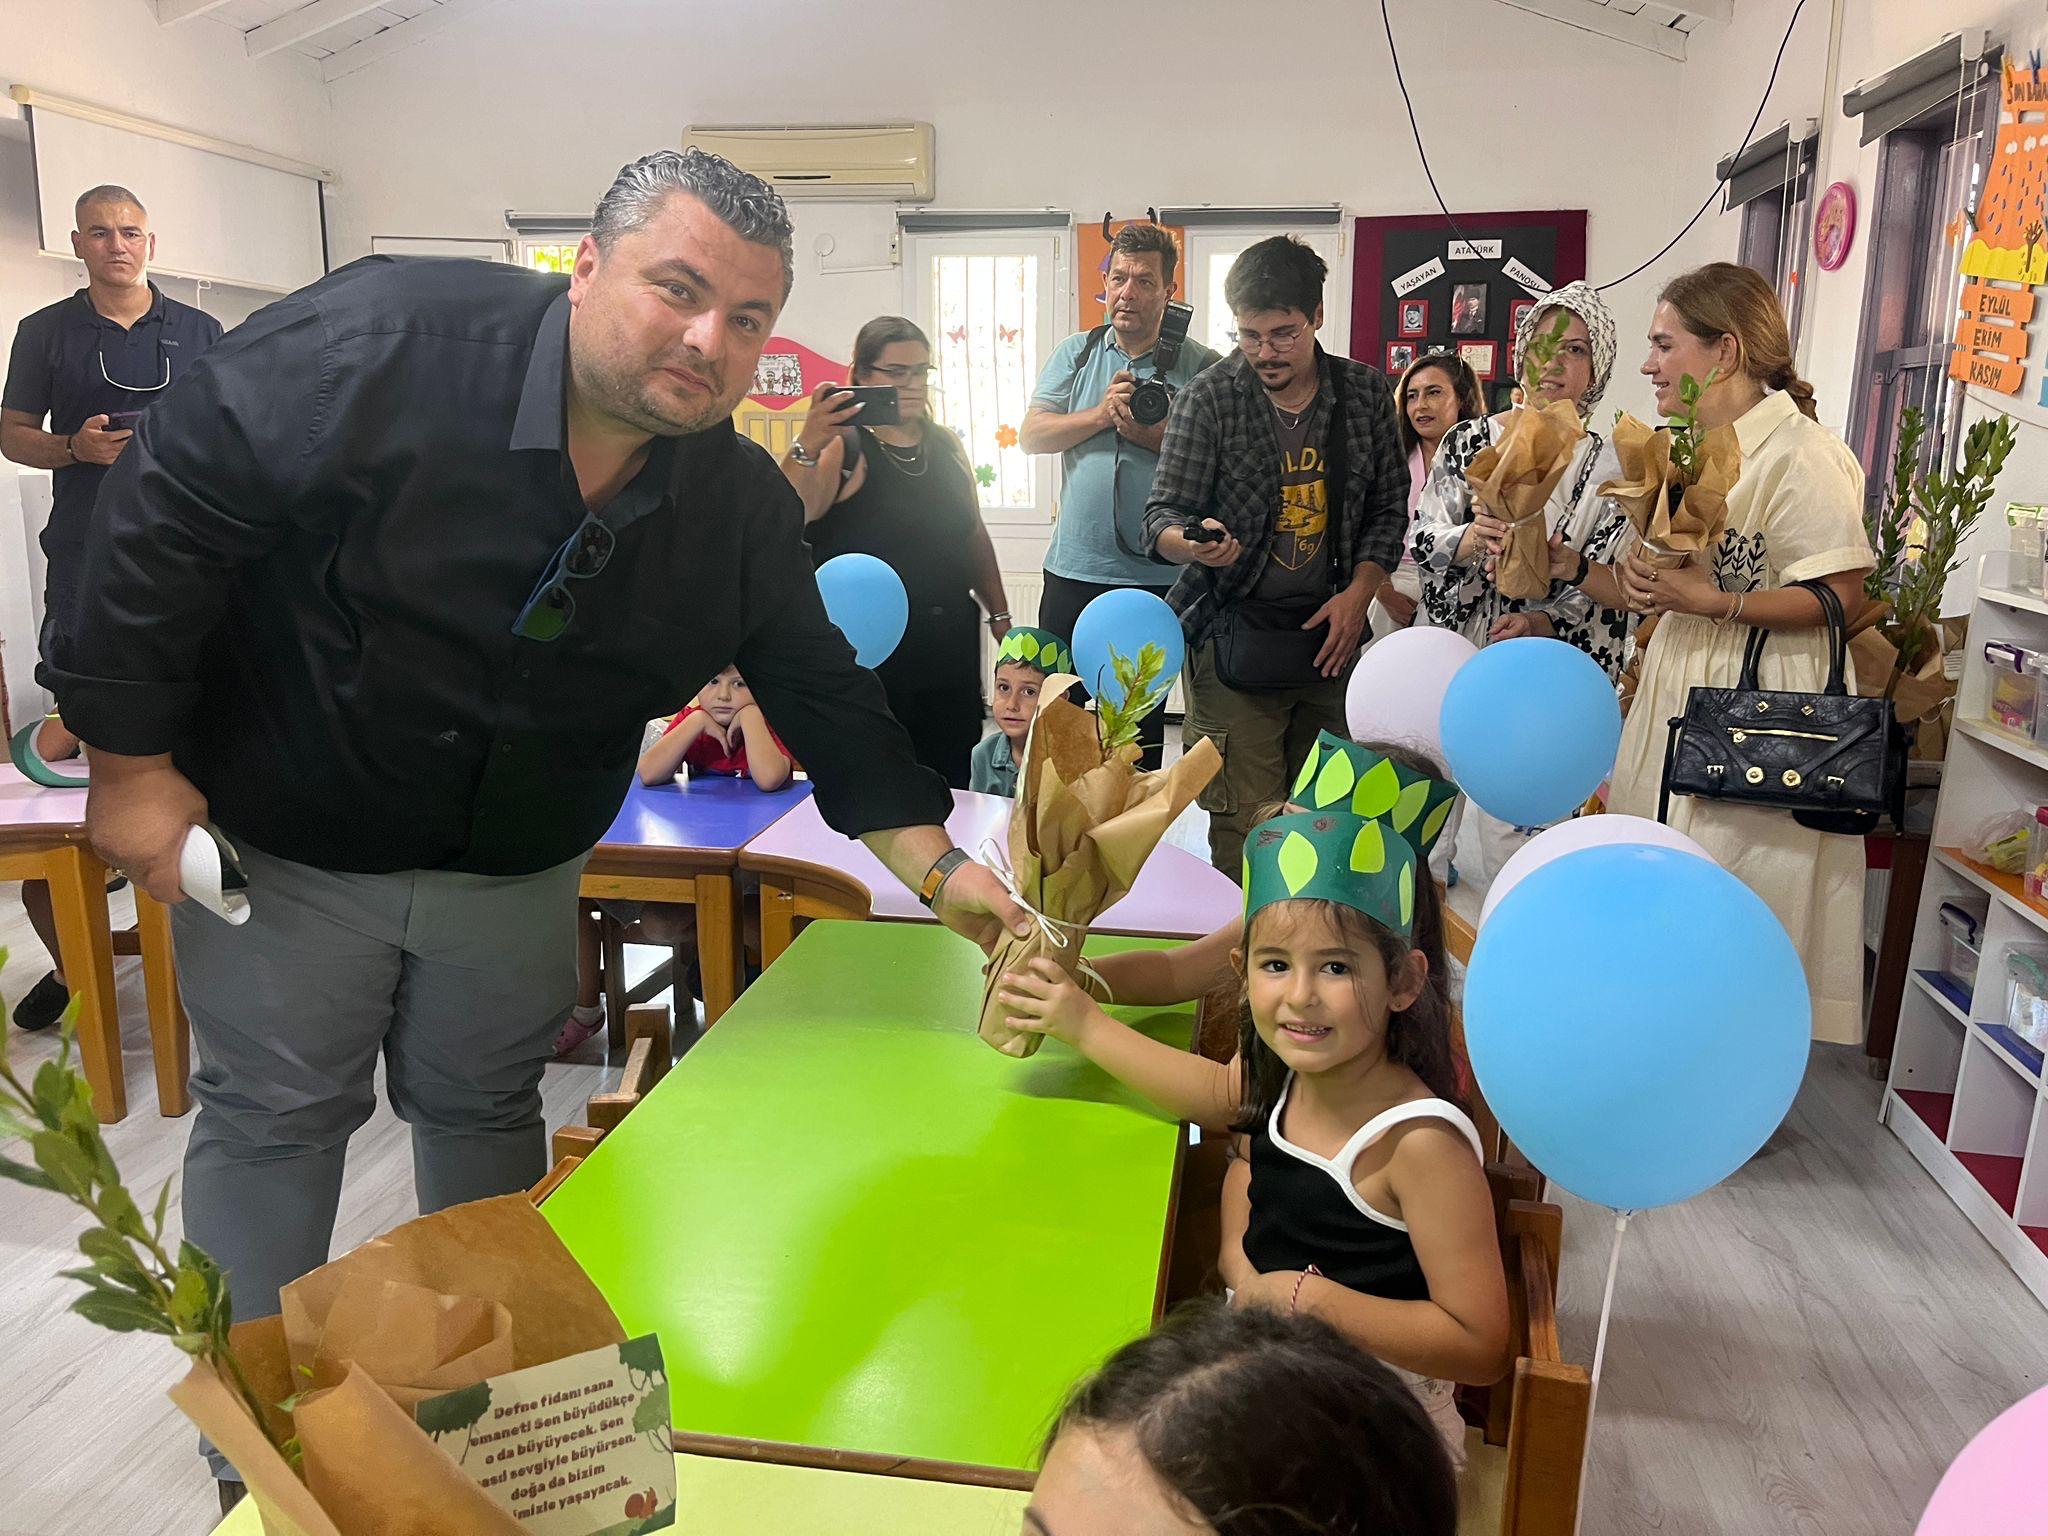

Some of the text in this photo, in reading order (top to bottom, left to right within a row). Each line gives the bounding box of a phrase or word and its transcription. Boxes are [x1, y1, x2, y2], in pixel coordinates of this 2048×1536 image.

[1454, 244, 1495, 255] ATATÜRK
[1400, 266, 1437, 290] YAŞAYAN
[1979, 293, 2011, 316] EYLÜL
[1973, 327, 2002, 348] EKİM
[1968, 361, 2002, 388] KASIM
[494, 1379, 614, 1420] Defne fidanı sana
[534, 1415, 561, 1430] Sen
[563, 1393, 635, 1422] büyüdükçe
[485, 1416, 624, 1465] o da büyüyecek. Sen
[477, 1469, 507, 1488] asıl
[510, 1454, 569, 1479] sevgiyle
[511, 1464, 606, 1501] doğa da bizim
[559, 1475, 632, 1510] yaşayacak.
